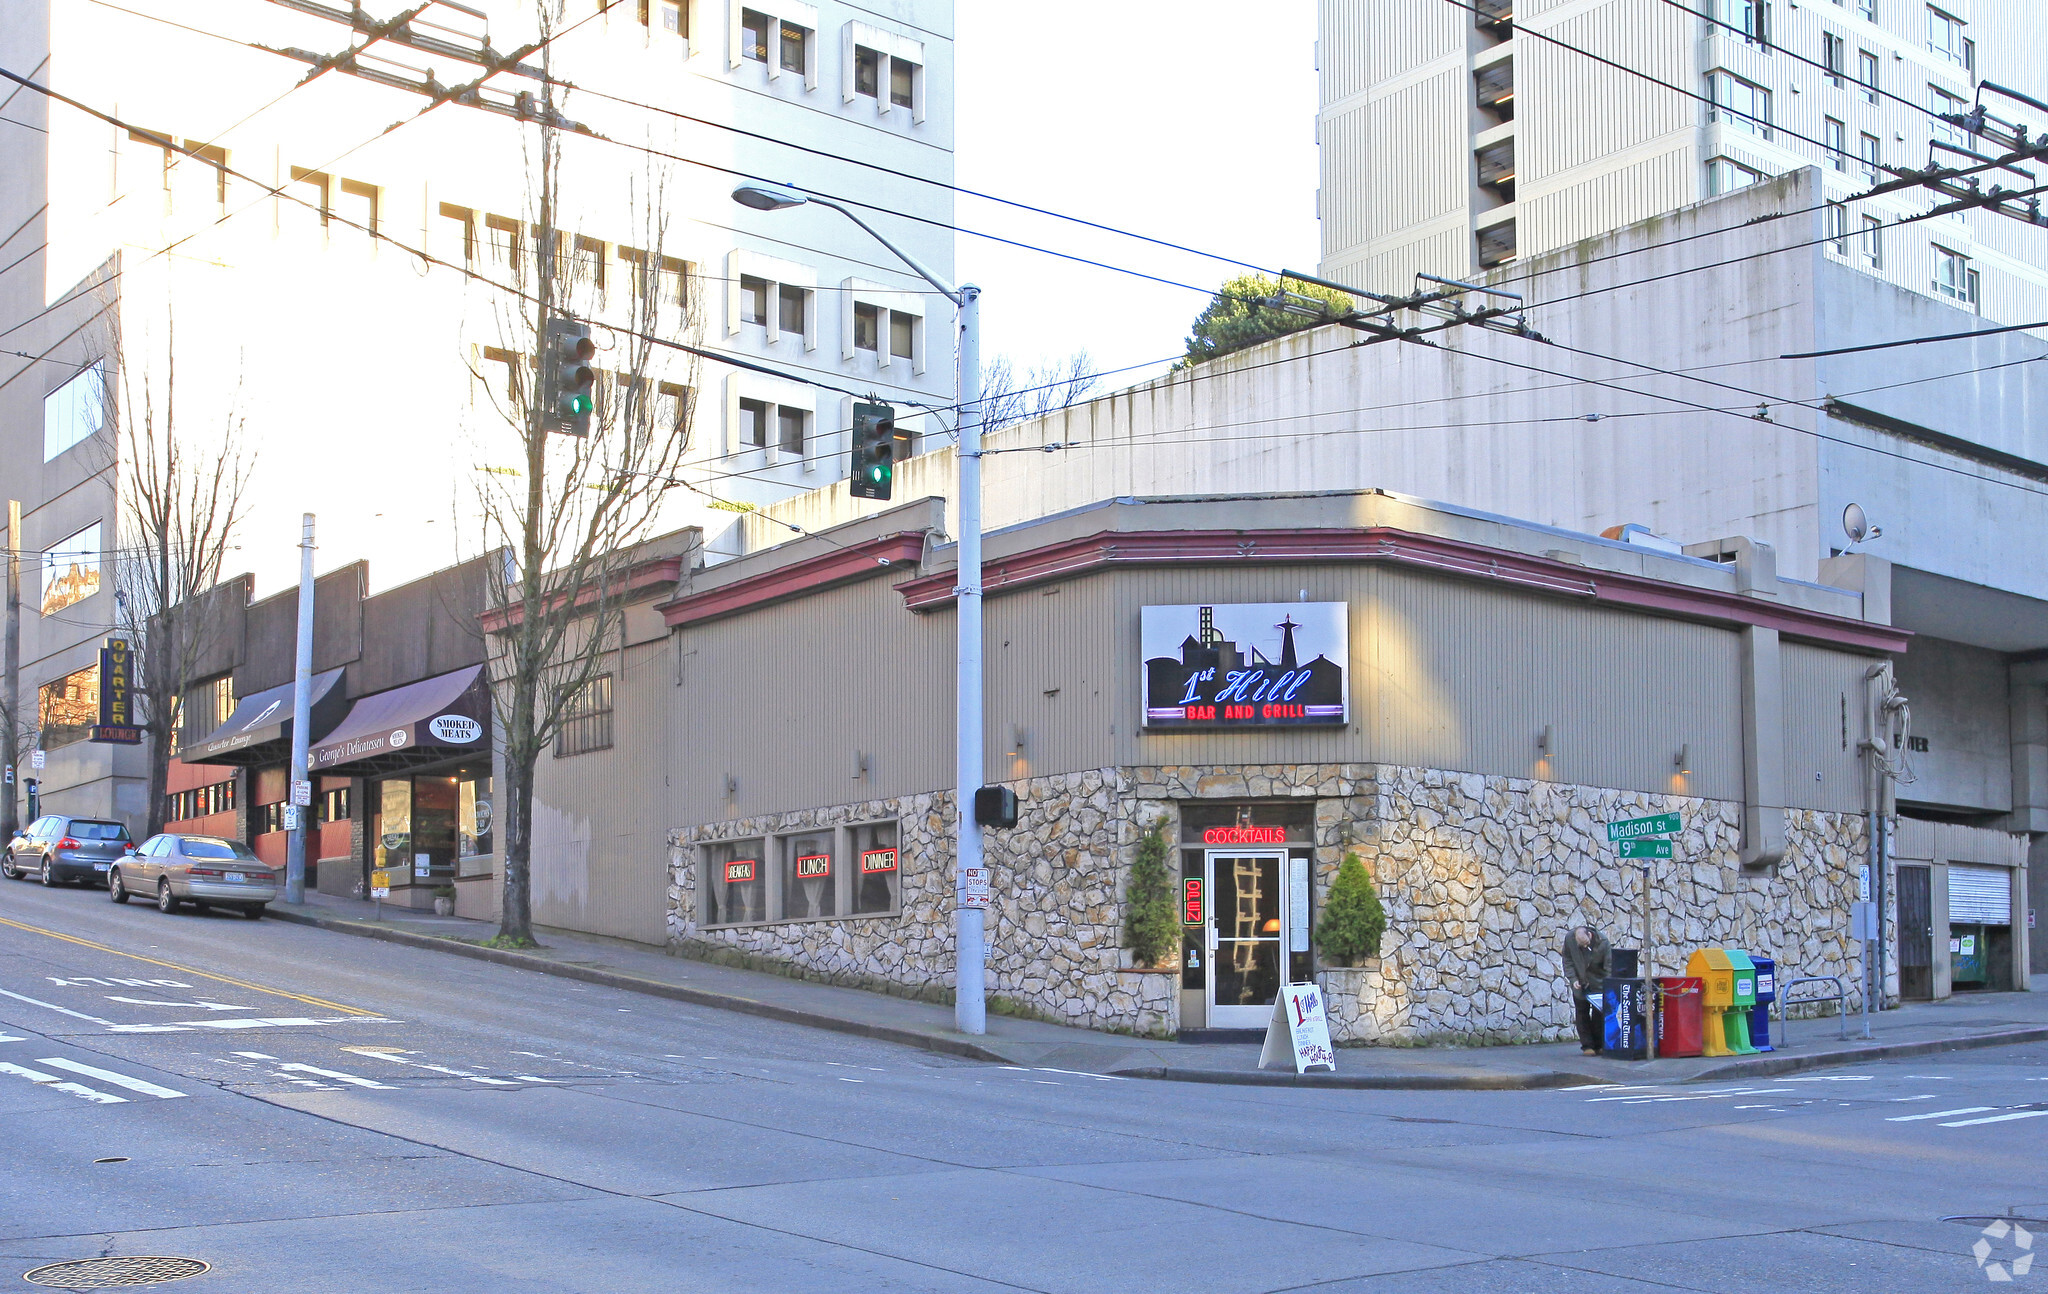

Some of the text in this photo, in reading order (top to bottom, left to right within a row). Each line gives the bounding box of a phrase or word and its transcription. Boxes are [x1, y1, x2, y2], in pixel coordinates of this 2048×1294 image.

[113, 640, 125, 724] QUARTER
[1179, 667, 1312, 704] 1st Hill
[1187, 704, 1304, 720] BAR AND GRILL
[437, 719, 475, 729] SMOKED
[100, 727, 137, 740] LOUNGE
[441, 729, 471, 739] MEATS
[320, 744, 345, 765] George's
[347, 738, 384, 756] Delicatessen
[1204, 828, 1286, 844] COCKTAILS
[1610, 821, 1666, 839] Madison St
[1622, 841, 1669, 856] 9th Ave
[799, 857, 827, 875] LUNCH
[864, 852, 895, 871] DINNER
[968, 878, 988, 886] STOPS
[1187, 881, 1201, 921] OPEN
[1622, 984, 1631, 1049] The Seattle Times
[1299, 1044, 1316, 1058] HAPPY
